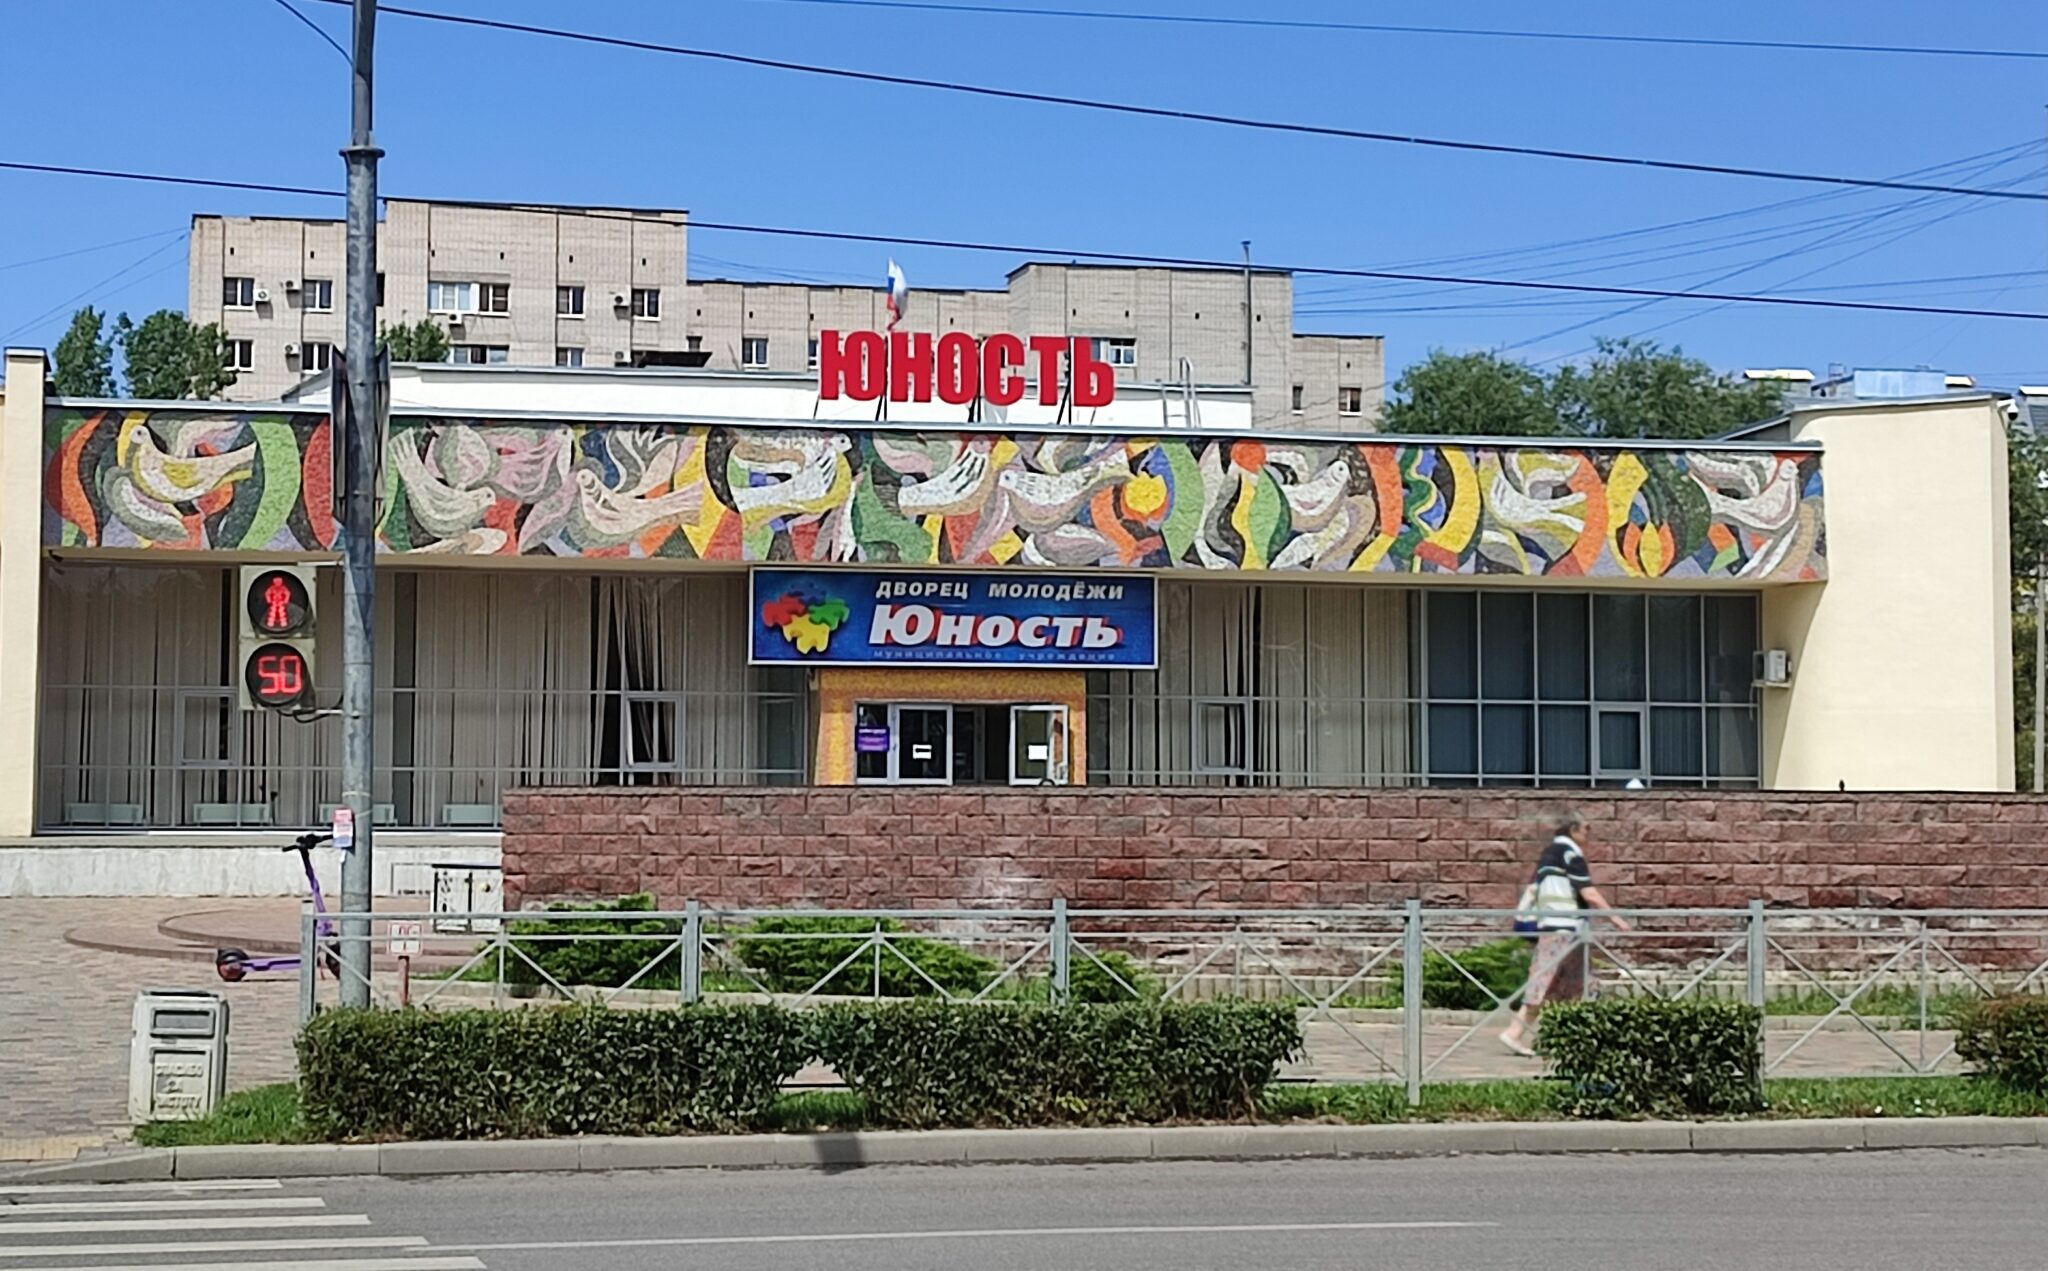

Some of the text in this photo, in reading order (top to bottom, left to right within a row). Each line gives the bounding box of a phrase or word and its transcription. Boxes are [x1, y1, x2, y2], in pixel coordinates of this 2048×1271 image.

[820, 330, 1114, 407] ЮНОСТЬ
[876, 580, 1124, 600] ДВОРЕЦ МОЛОДЁЖИ
[869, 604, 1121, 648] Юность
[258, 655, 302, 694] 50
